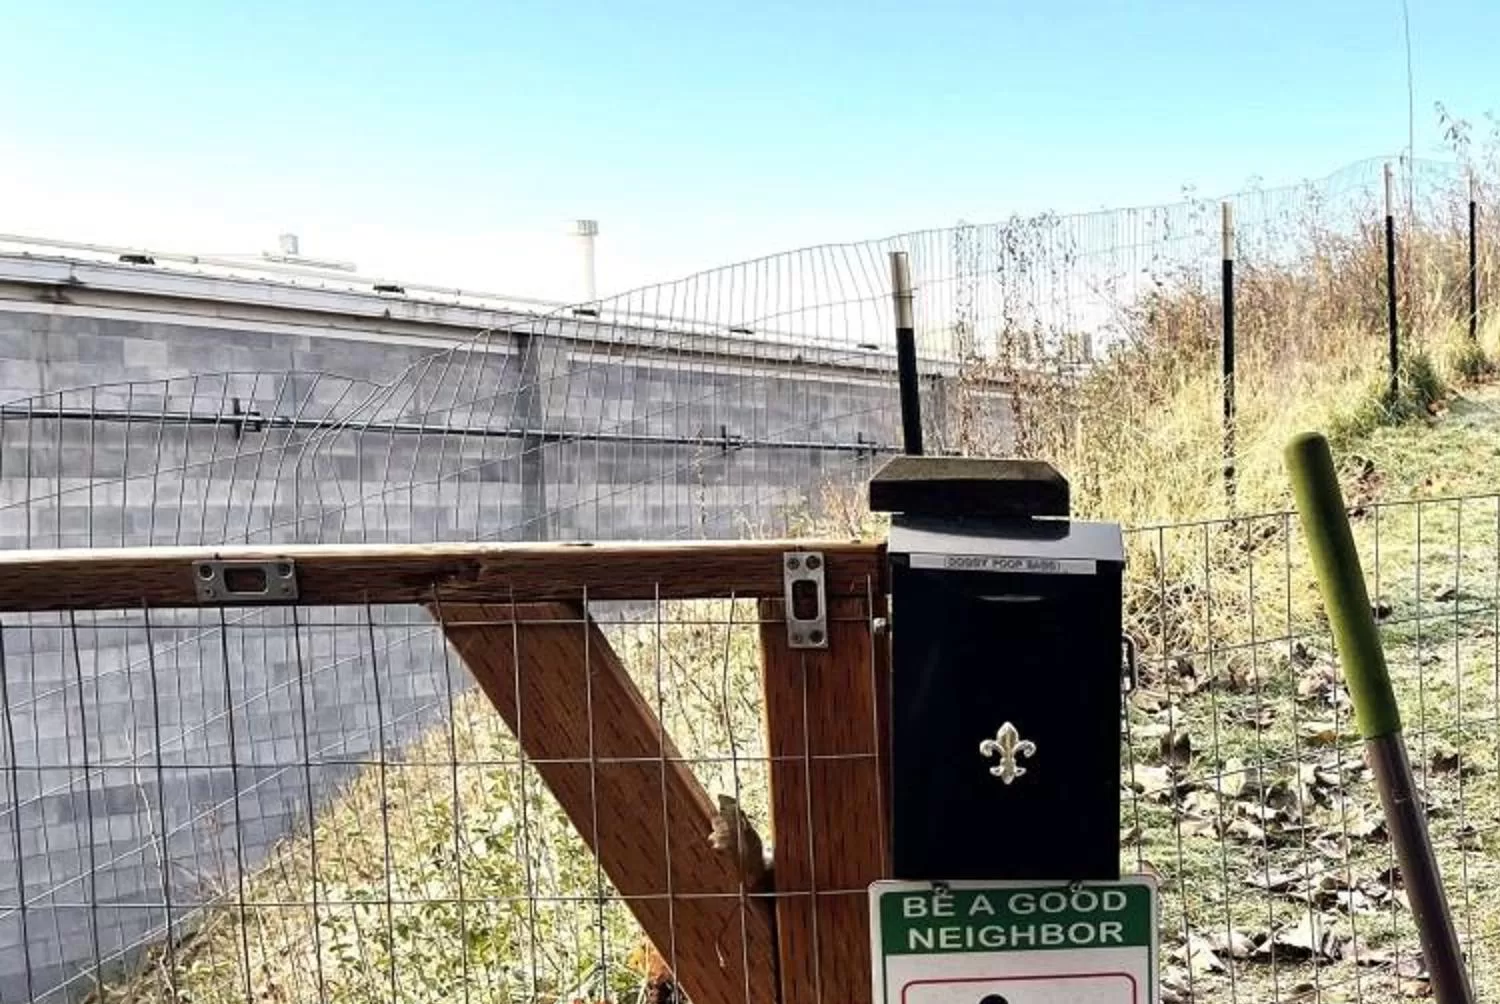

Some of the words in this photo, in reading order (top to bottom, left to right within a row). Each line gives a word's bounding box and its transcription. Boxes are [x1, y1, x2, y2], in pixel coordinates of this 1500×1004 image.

[947, 557, 988, 568] DOGGY
[992, 559, 1023, 569] POOP
[903, 895, 955, 917] BE
[968, 894, 996, 916] A
[1007, 890, 1127, 915] GOOD
[908, 921, 1124, 949] NEIGHBOR
